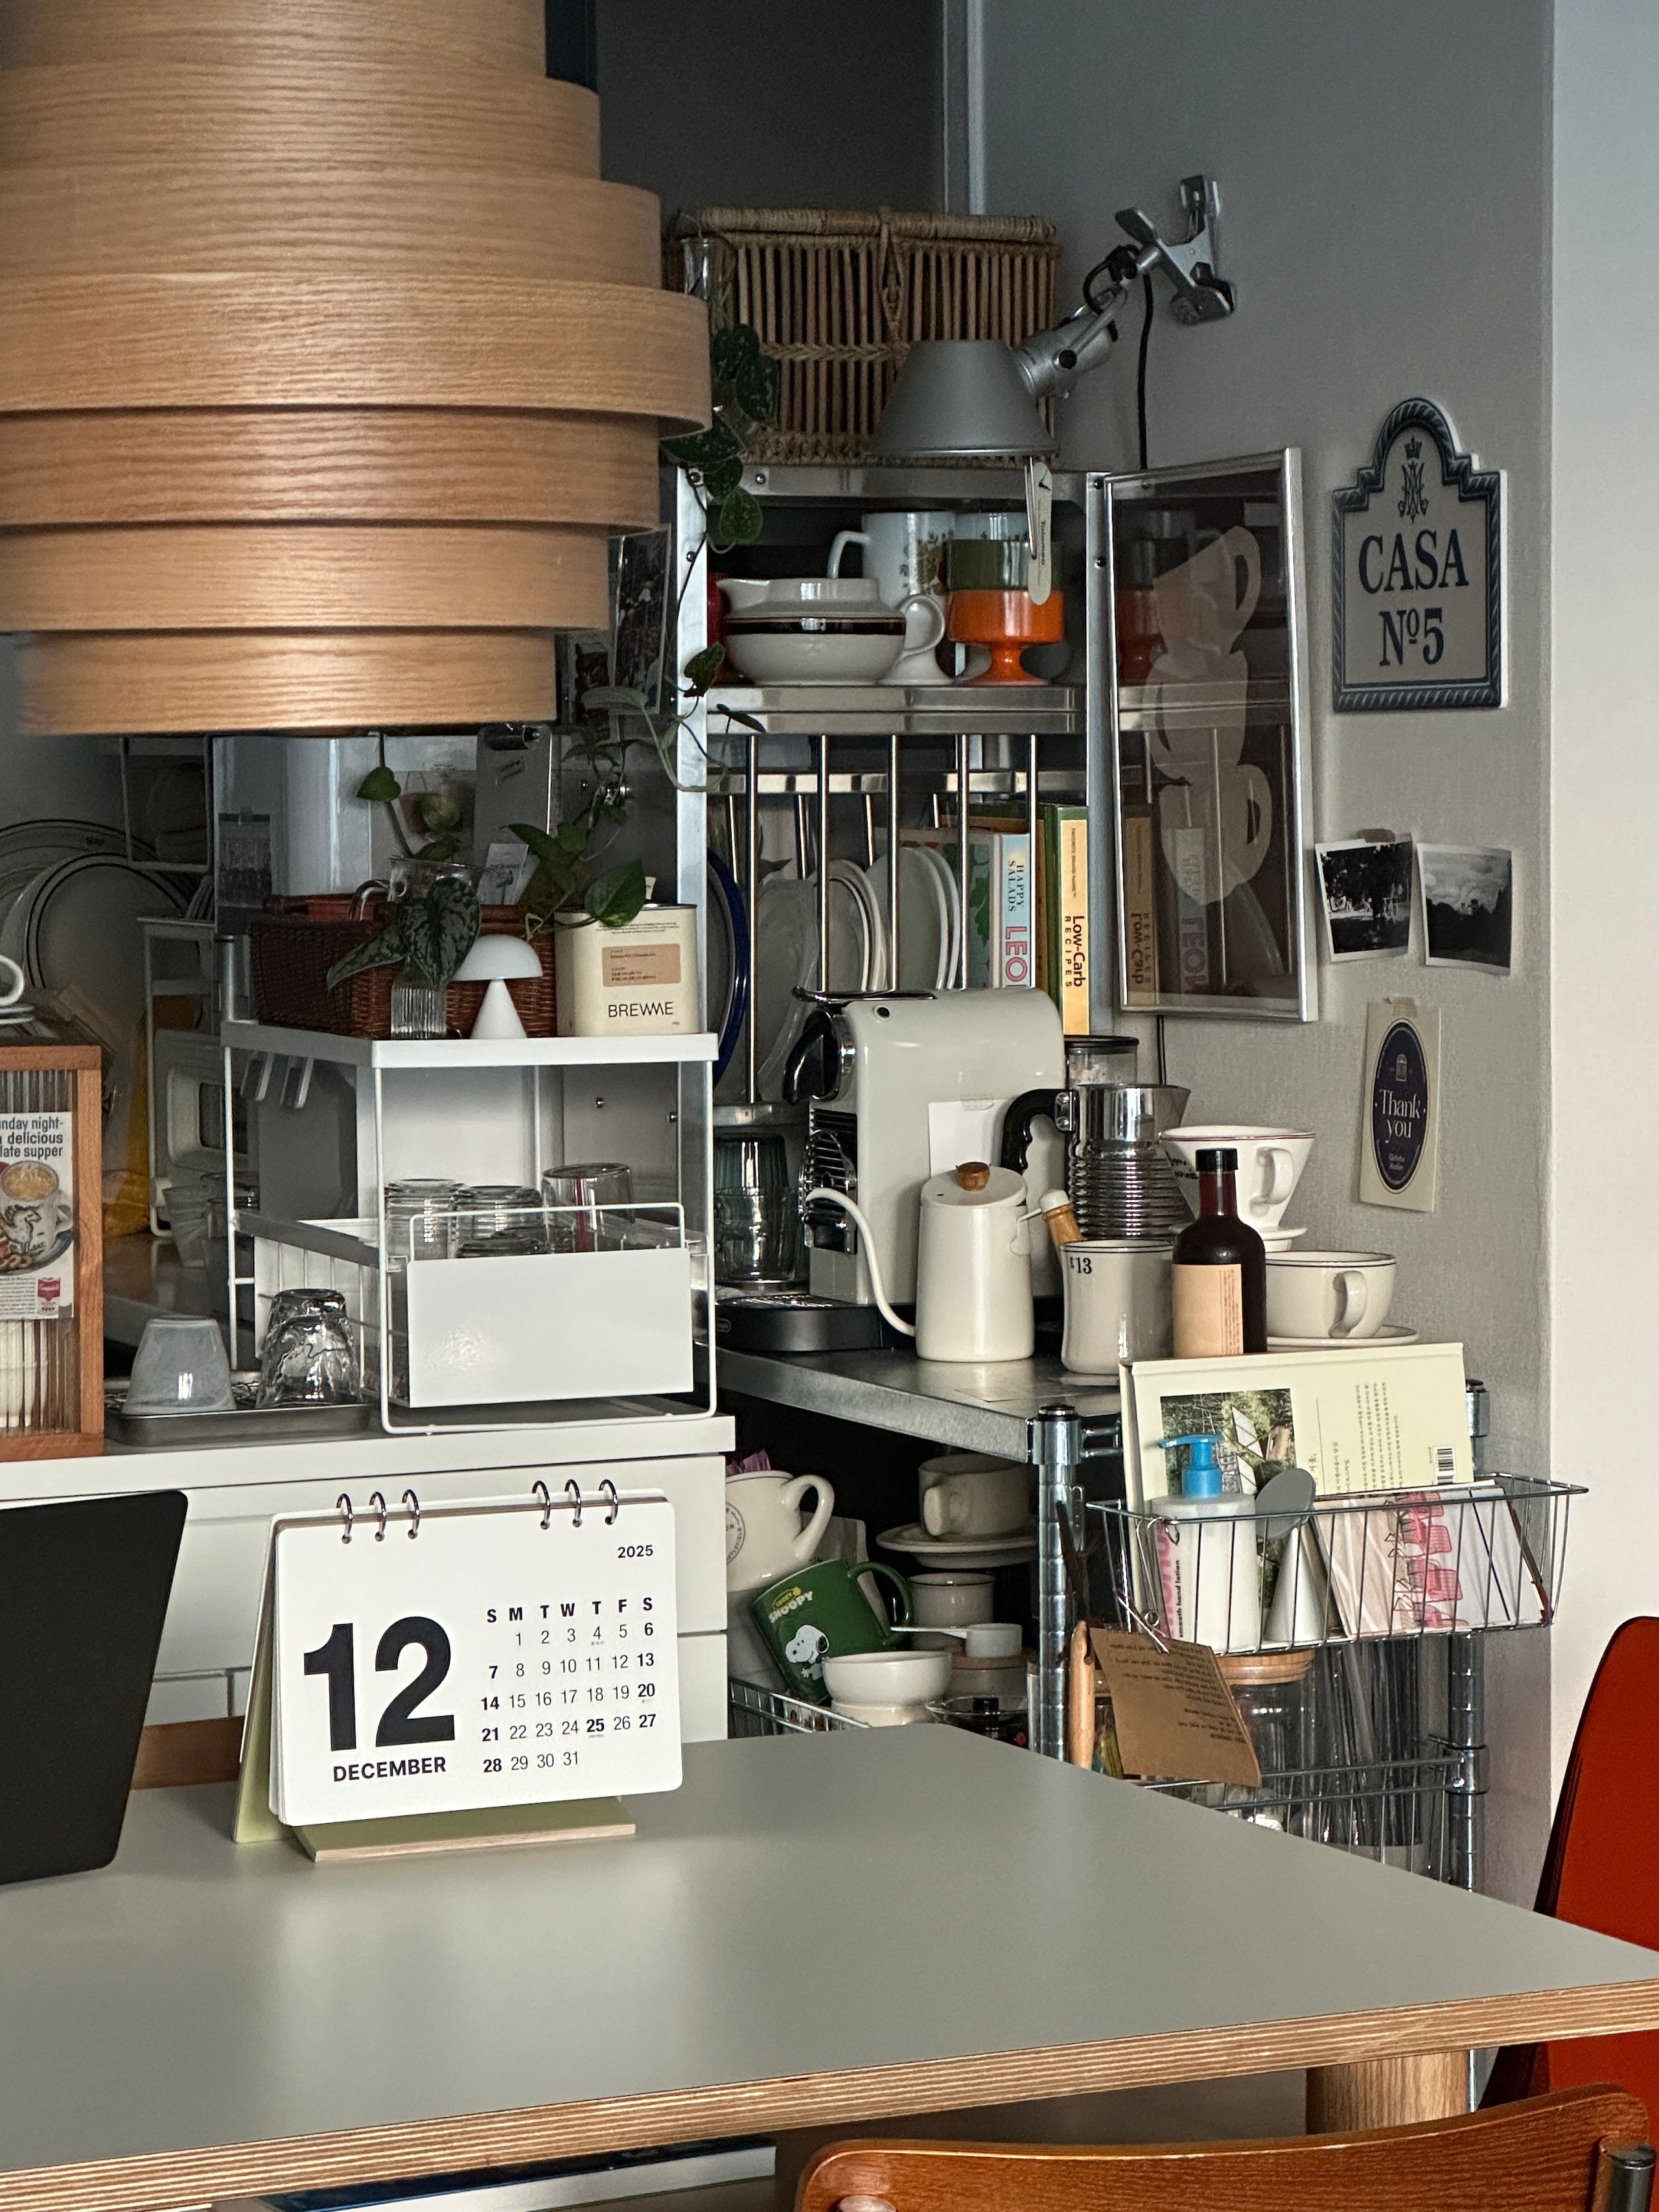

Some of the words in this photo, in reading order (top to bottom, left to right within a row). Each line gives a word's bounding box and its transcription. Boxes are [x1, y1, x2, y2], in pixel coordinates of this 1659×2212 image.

[1358, 529, 1469, 594] CASA
[1008, 860, 1016, 912] SALADS
[1016, 865, 1025, 908] HAPPY
[1005, 926, 1028, 987] LEO
[1064, 916, 1073, 987] RECIPES
[1073, 916, 1086, 987] Low-Carb
[1379, 1089, 1421, 1119] Thank
[0, 1116, 29, 1131] nday
[8, 1131, 64, 1145] delicious
[1385, 1119, 1412, 1143] you
[0, 1145, 21, 1158] late
[24, 1147, 64, 1160] supper
[618, 1544, 653, 1559] 2025
[487, 1609, 497, 1624] S
[509, 1607, 523, 1622] M
[540, 1604, 550, 1619] T
[560, 1603, 575, 1618] W
[592, 1600, 602, 1615] T
[618, 1598, 627, 1613] F
[643, 1597, 653, 1611] S
[769, 1590, 813, 1623] SNOOPY
[515, 1632, 521, 1646] 1
[541, 1630, 550, 1644] 2
[567, 1628, 576, 1642] 3
[593, 1625, 601, 1640] 4
[619, 1624, 627, 1638] 5
[644, 1622, 654, 1636] 6
[489, 1665, 498, 1679] 7
[516, 1662, 525, 1677] 8
[542, 1660, 551, 1675] 9
[559, 1659, 577, 1673] 10
[586, 1656, 600, 1671] 11
[612, 1655, 629, 1670] 12
[637, 1652, 655, 1667] 13
[303, 1616, 456, 1752] 12
[481, 1696, 500, 1711] 14
[509, 1694, 526, 1708] 15
[535, 1692, 551, 1706] 16
[561, 1689, 577, 1705] 17
[586, 1687, 604, 1702] 18
[612, 1685, 629, 1700] 19
[637, 1682, 655, 1697] 20
[481, 1727, 498, 1742] 21
[509, 1725, 527, 1740] 22
[535, 1722, 553, 1738] 23
[561, 1720, 579, 1735] 24
[586, 1718, 605, 1733] 25
[613, 1716, 631, 1730] 26
[638, 1713, 656, 1729] 27
[333, 1756, 447, 1782] DECEMBER
[483, 1758, 502, 1773] 28
[511, 1756, 528, 1771] 29
[537, 1753, 554, 1769] 30
[563, 1751, 578, 1766] 31
